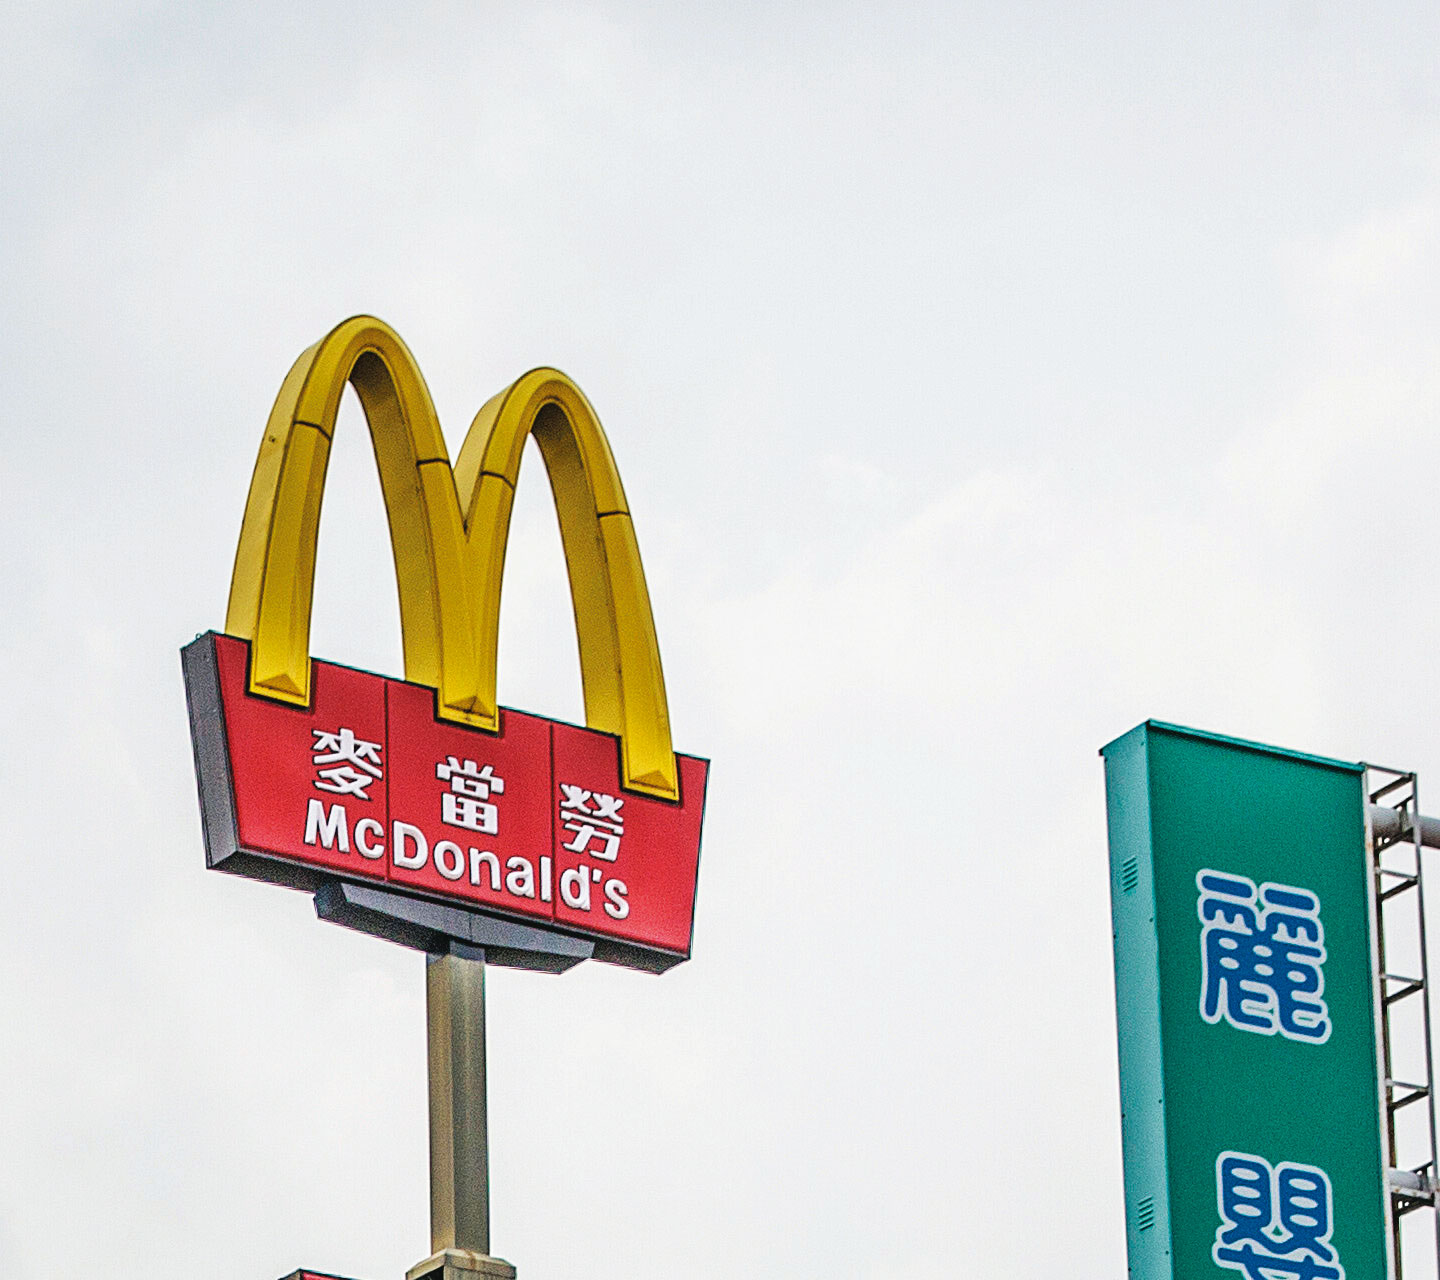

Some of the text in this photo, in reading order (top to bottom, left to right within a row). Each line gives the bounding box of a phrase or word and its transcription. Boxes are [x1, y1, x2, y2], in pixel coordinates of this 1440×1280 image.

[303, 798, 631, 920] McDonald's
[312, 727, 625, 863] 麥當勞
